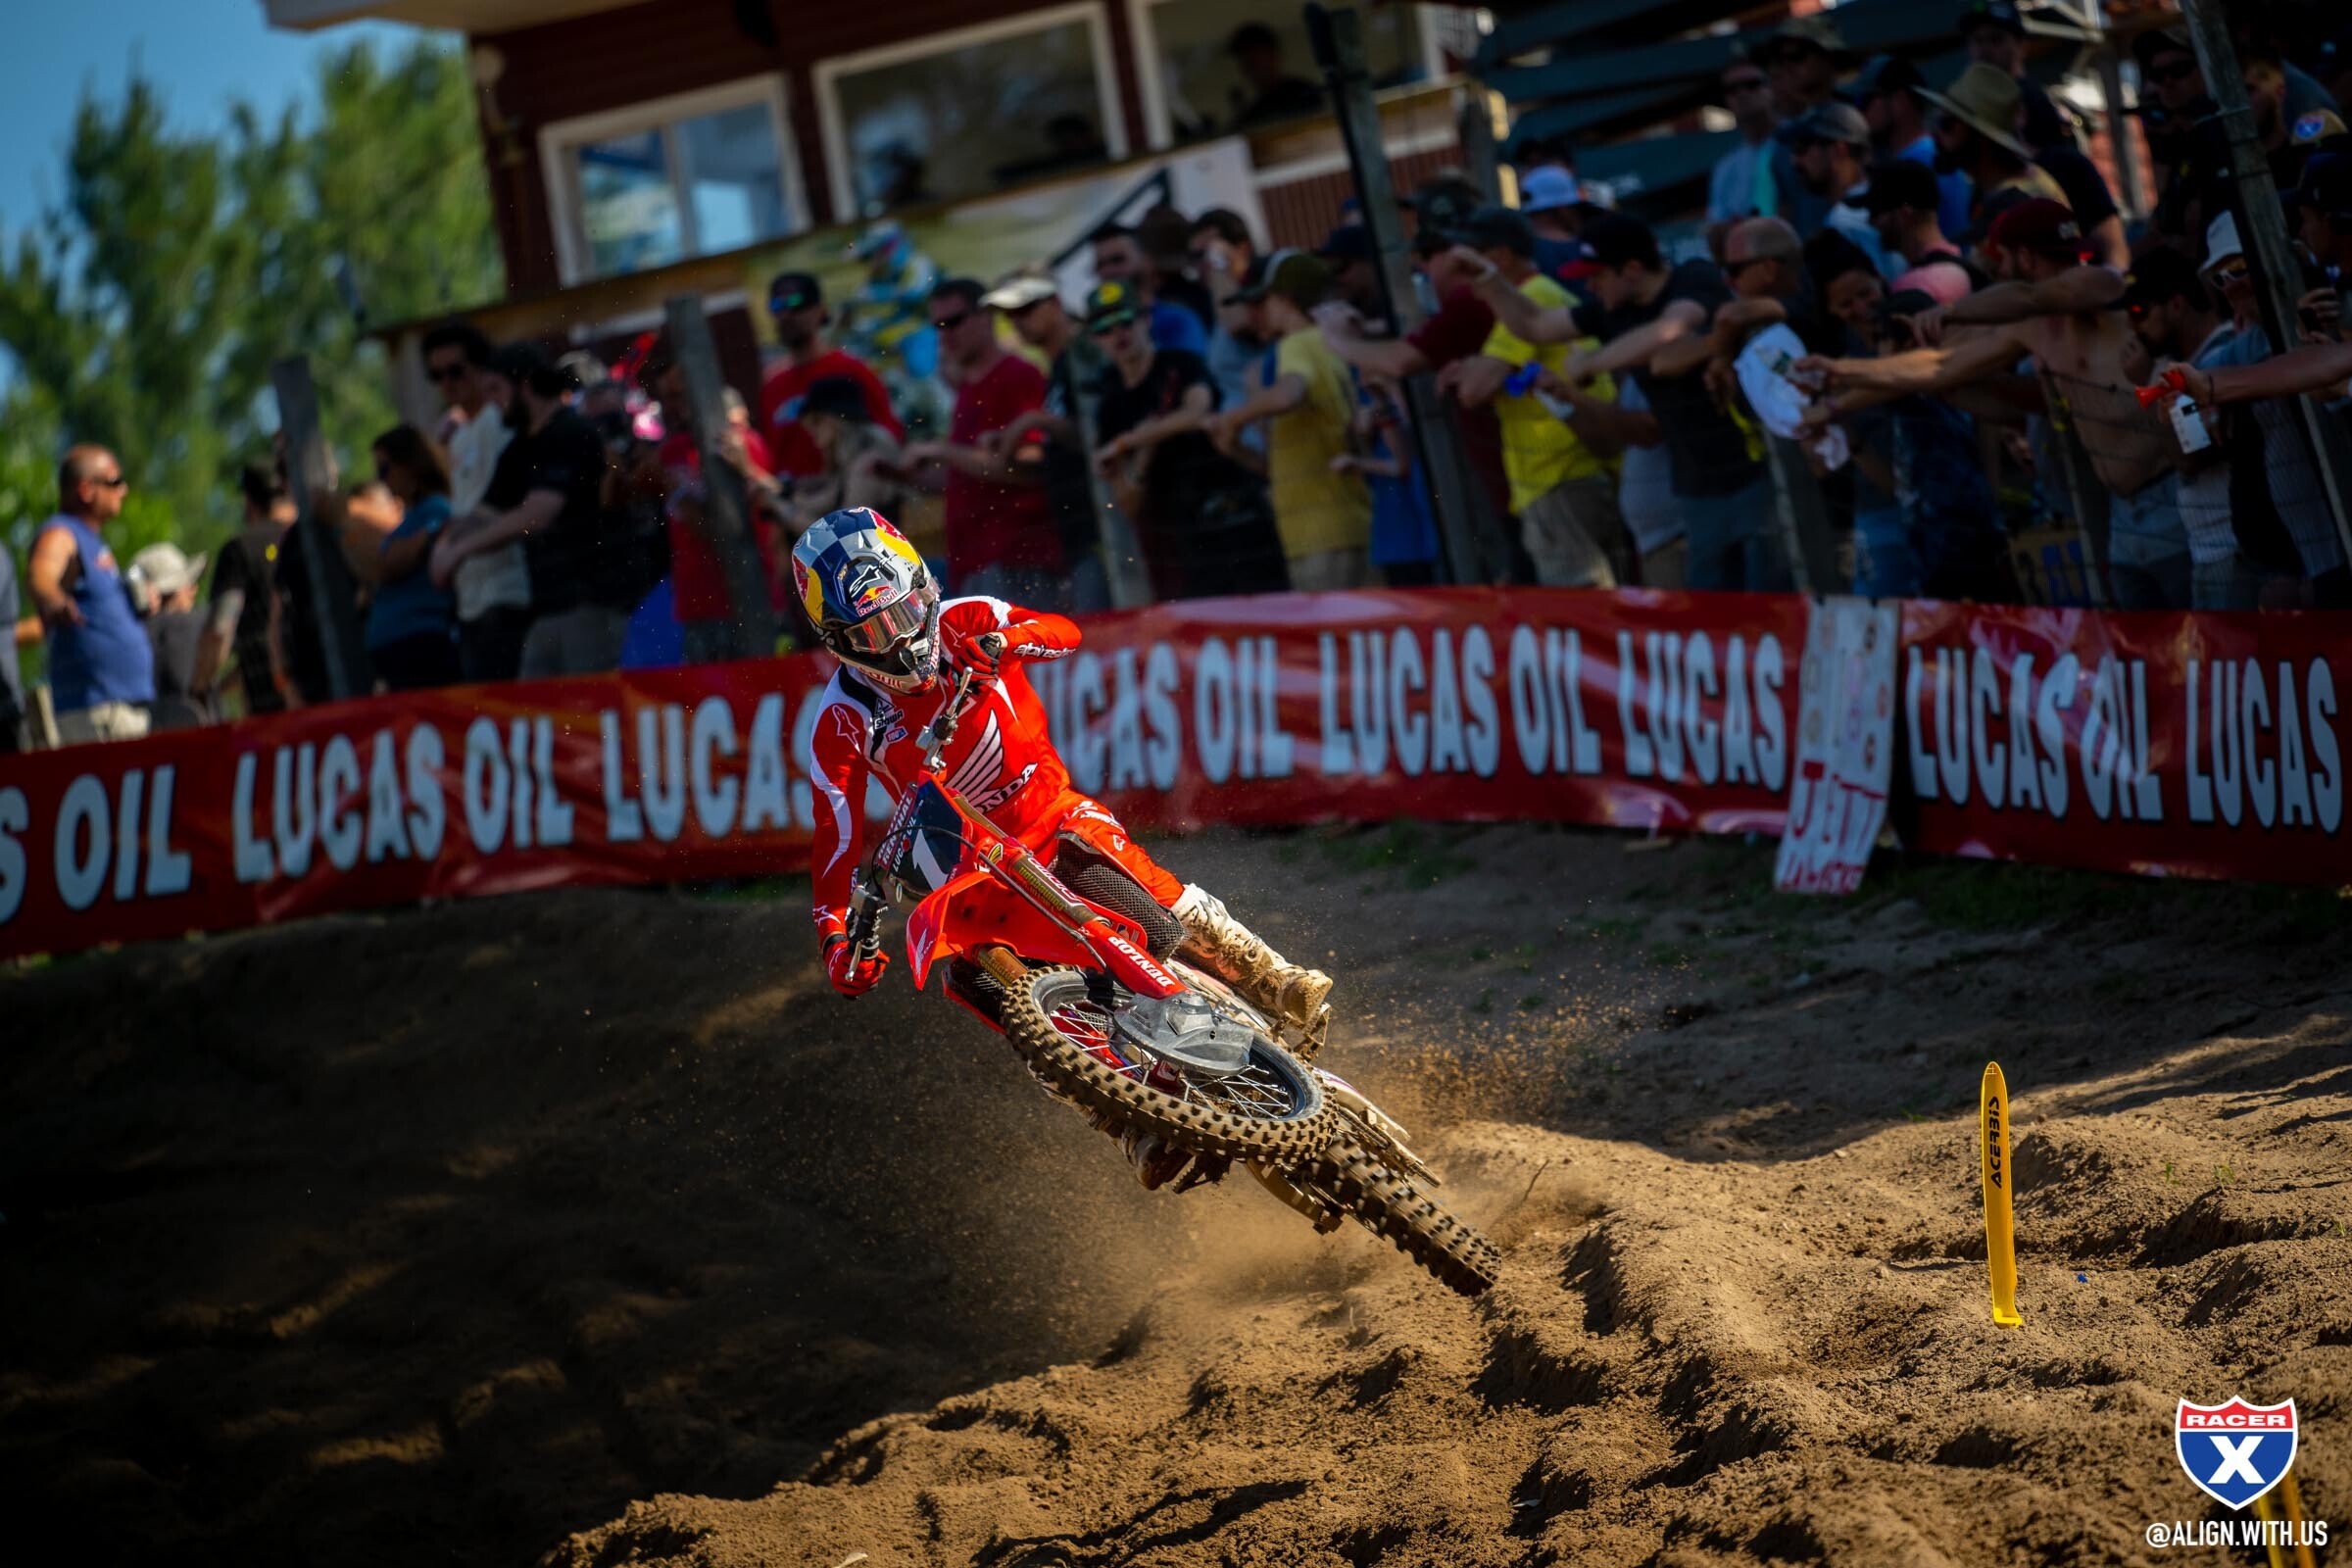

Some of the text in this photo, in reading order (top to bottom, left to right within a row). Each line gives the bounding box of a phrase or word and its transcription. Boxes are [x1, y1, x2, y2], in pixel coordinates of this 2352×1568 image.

[974, 762, 1038, 814] NDA
[1030, 623, 1787, 796] UCAS OIL LUCAS OIL LUCAS
[1906, 643, 2079, 820] LUCAS
[2185, 656, 2343, 834] LUCAS
[54, 764, 191, 910] OIL
[231, 722, 446, 882] LUCAS
[464, 716, 574, 855] OIL
[1107, 936, 1176, 988] DUNLOP
